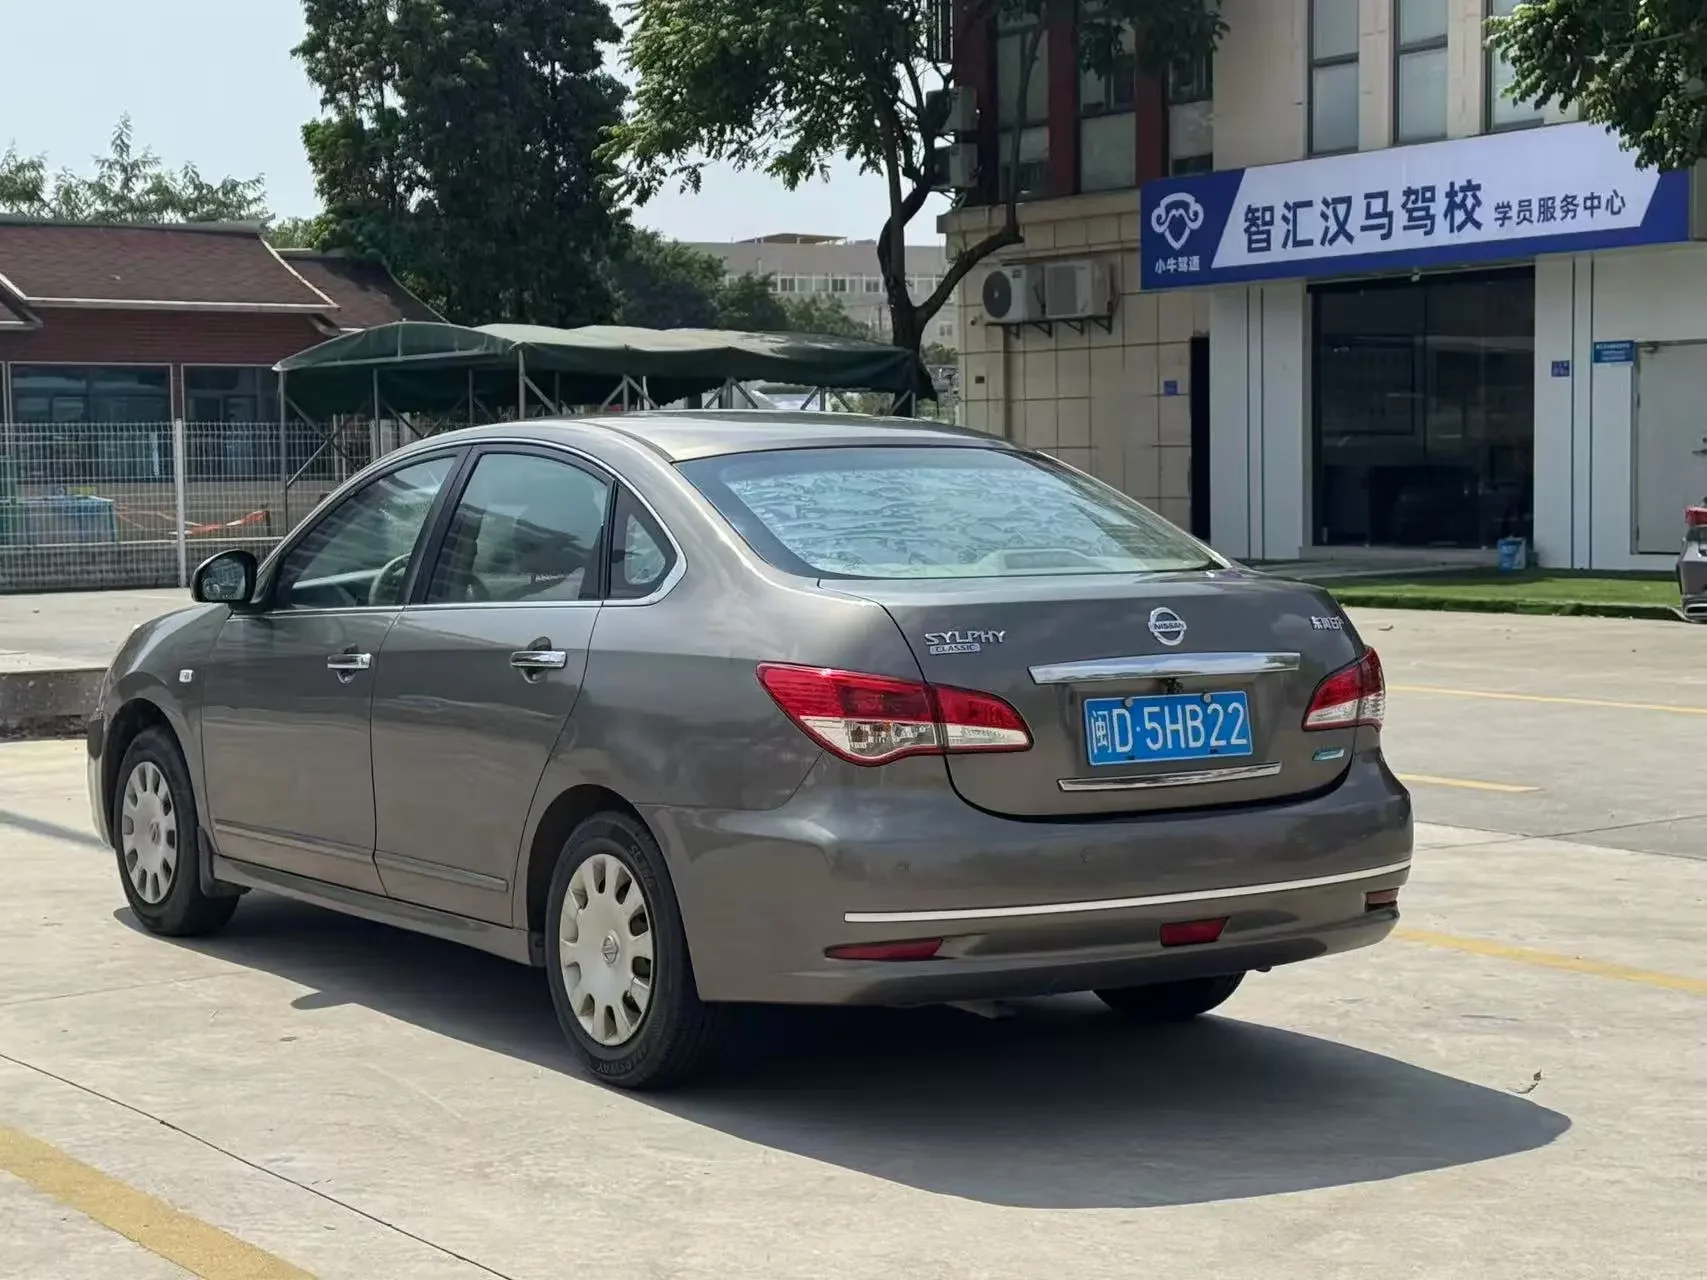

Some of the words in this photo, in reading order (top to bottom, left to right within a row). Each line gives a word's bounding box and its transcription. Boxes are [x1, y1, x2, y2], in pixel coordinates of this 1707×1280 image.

[1243, 178, 1483, 254] 智汇汉马驾校
[1494, 189, 1626, 228] 学员服务中心
[924, 630, 1006, 645] SYLPHY
[933, 643, 980, 654] CLASSIC
